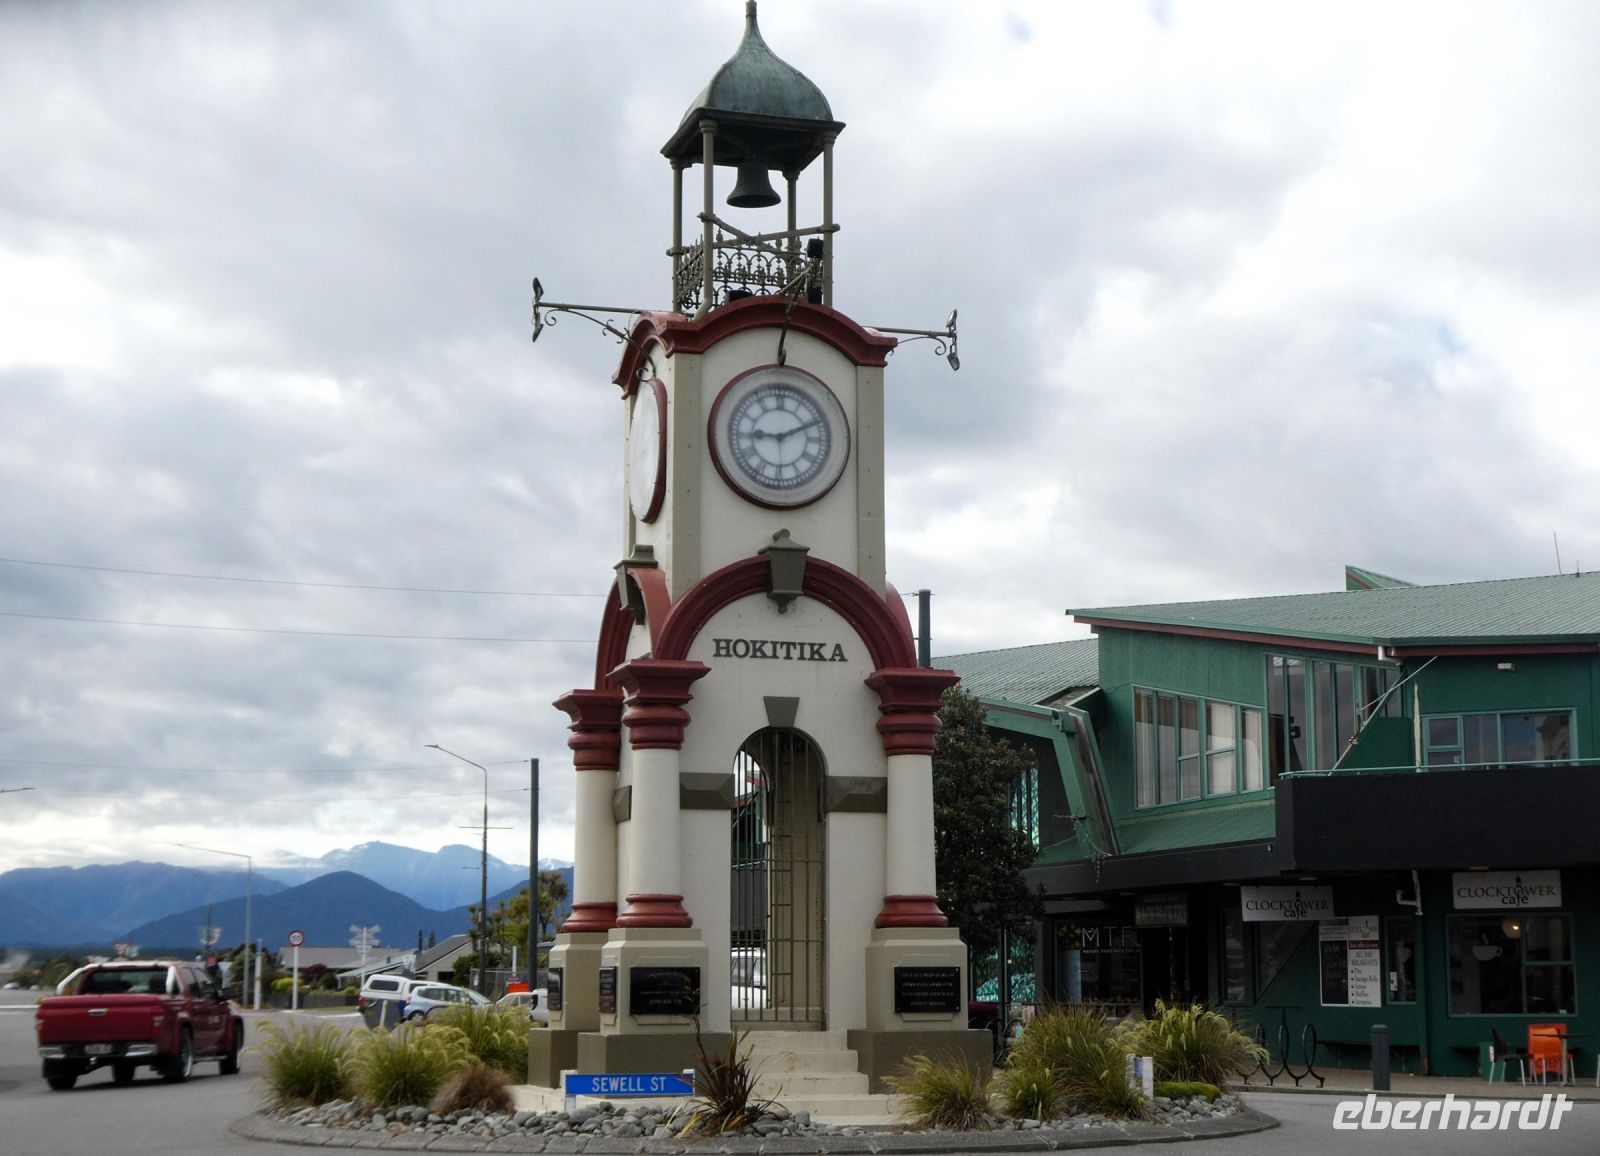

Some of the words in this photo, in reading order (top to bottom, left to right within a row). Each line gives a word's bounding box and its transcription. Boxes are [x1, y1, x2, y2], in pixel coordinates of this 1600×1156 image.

[712, 638, 849, 662] HOKITIKA
[1456, 885, 1555, 898] CLOCKTOWER
[1245, 899, 1329, 911] CLOCKTOWER
[592, 1077, 645, 1092] SEWELL
[650, 1077, 666, 1092] ST
